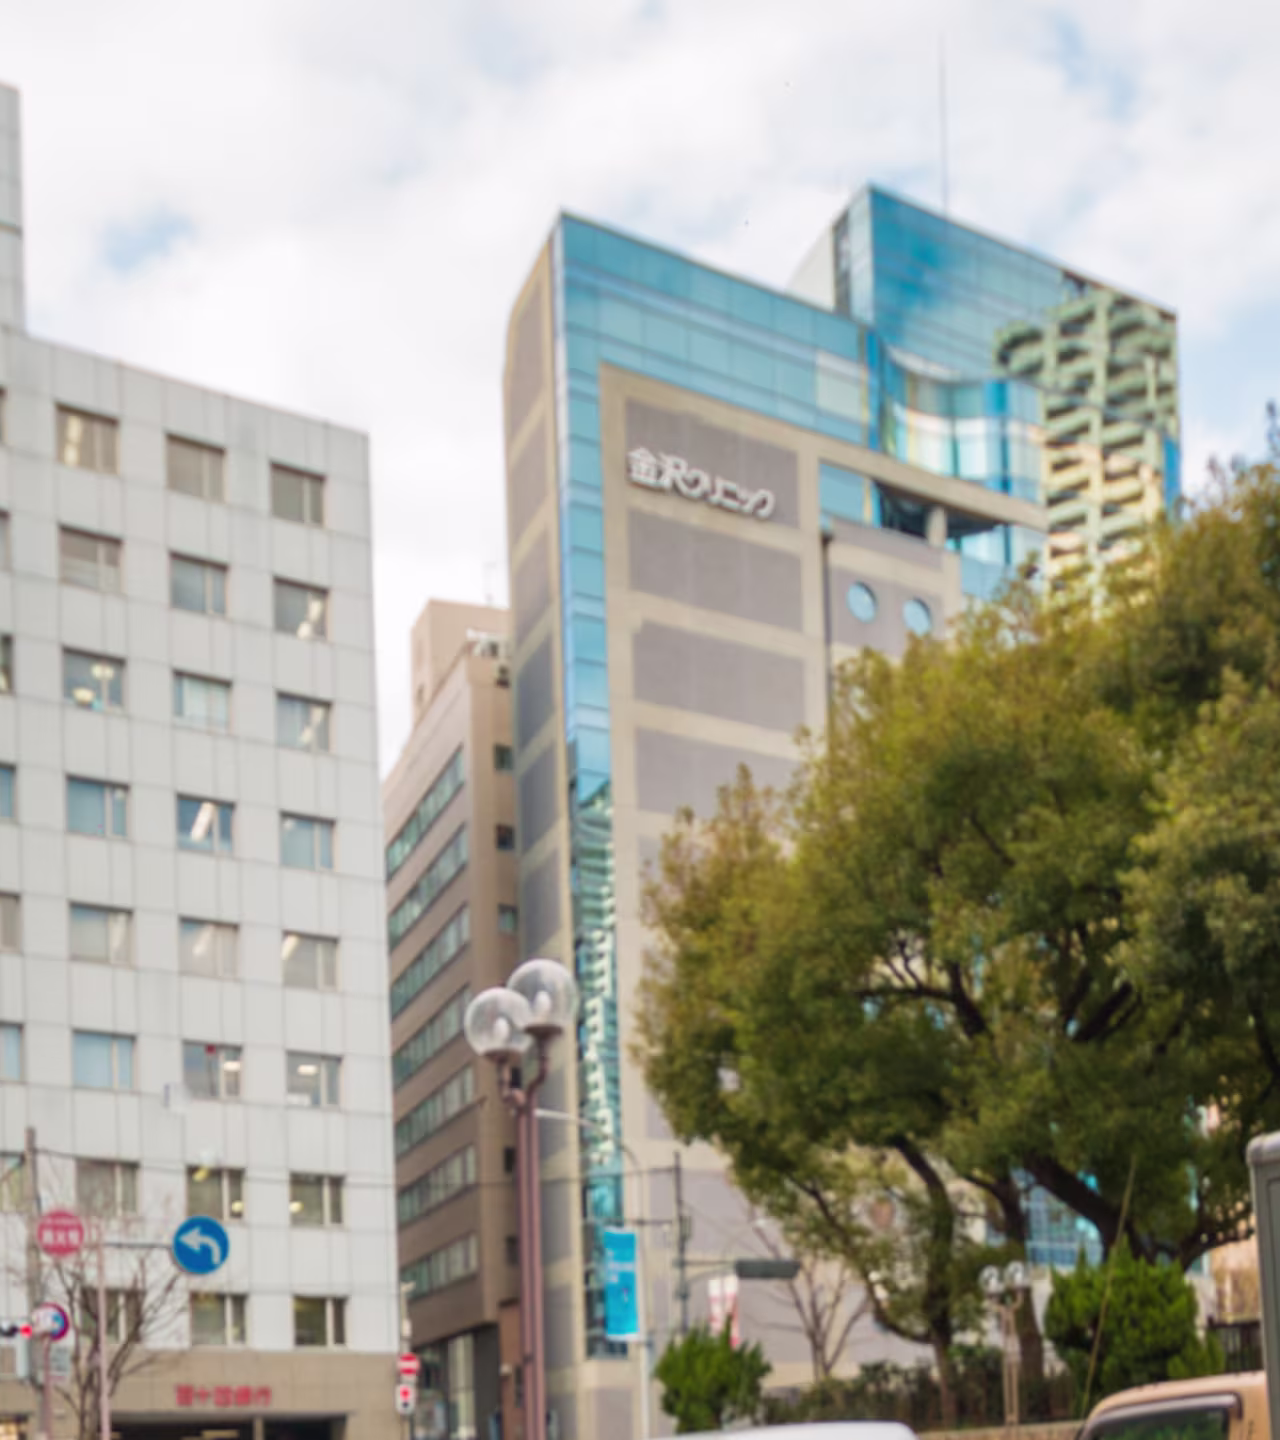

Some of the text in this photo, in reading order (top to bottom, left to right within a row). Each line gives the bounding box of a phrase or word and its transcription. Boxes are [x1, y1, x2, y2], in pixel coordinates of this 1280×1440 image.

[627, 447, 774, 518] 金沢クリニック
